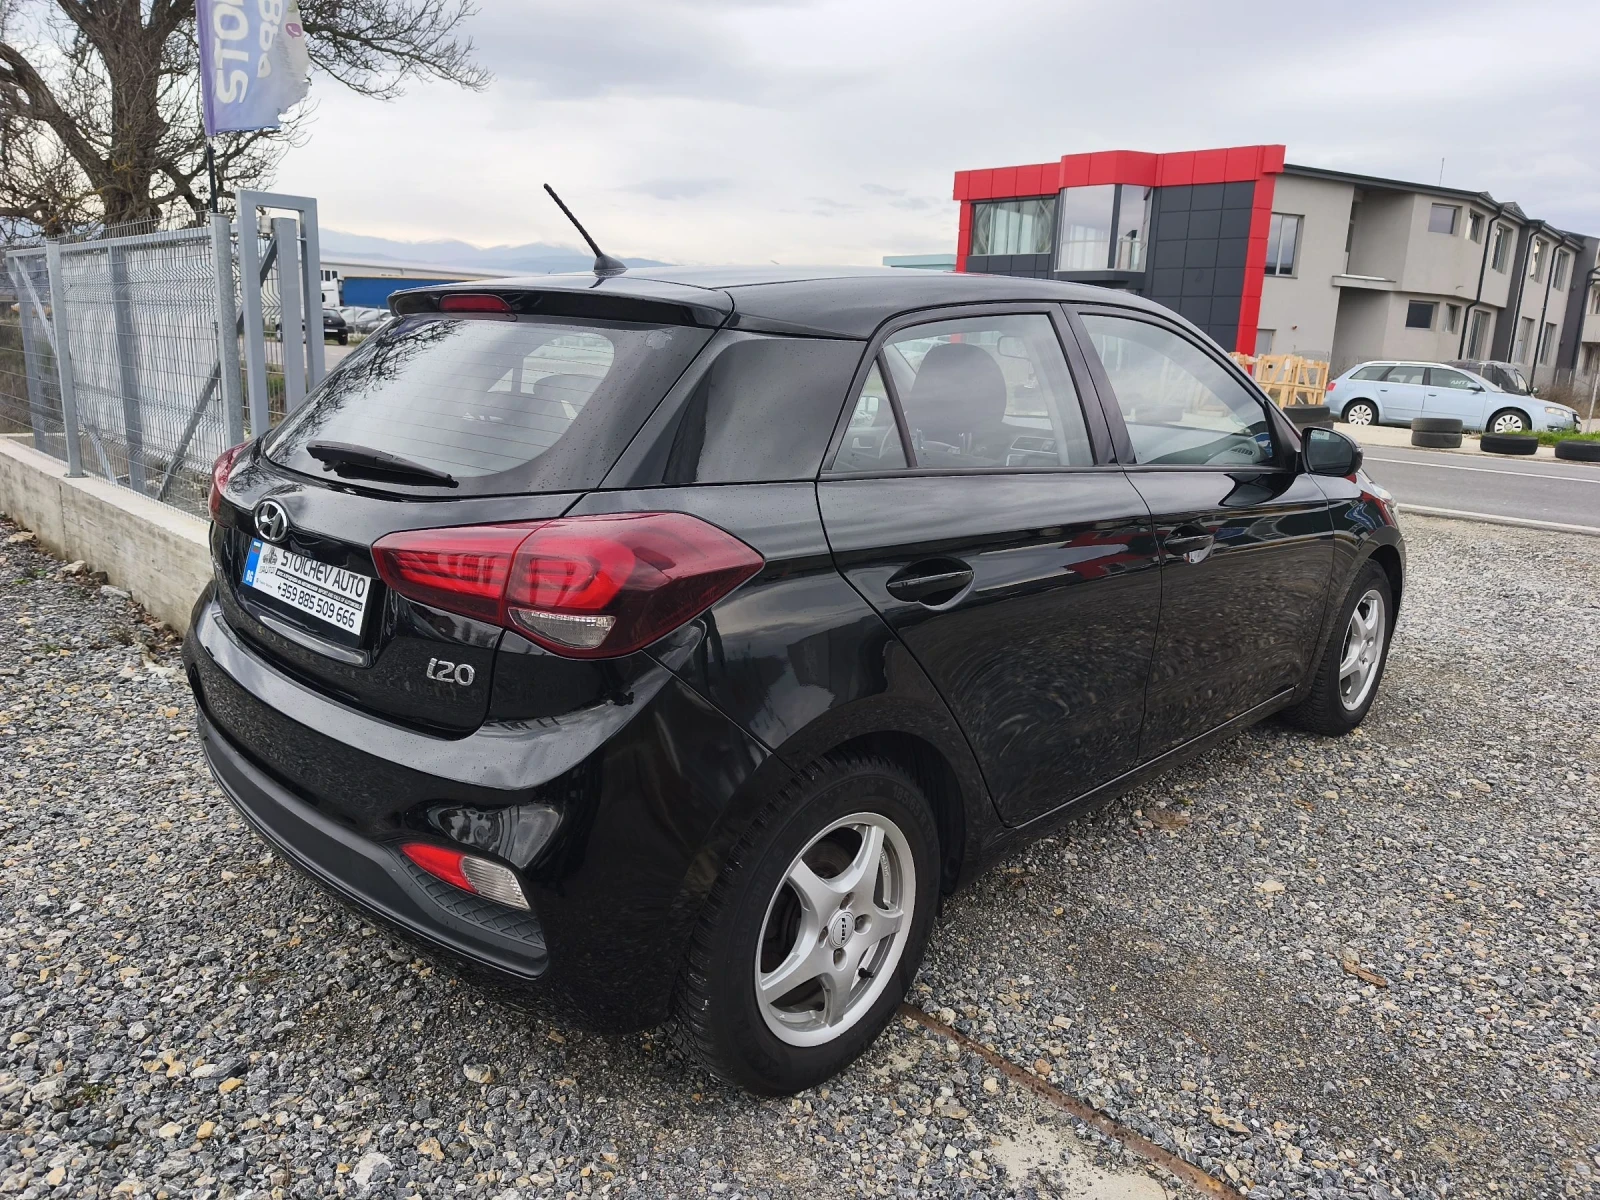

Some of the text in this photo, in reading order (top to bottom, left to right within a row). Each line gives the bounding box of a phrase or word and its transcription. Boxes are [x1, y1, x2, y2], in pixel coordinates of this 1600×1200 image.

[280, 550, 335, 584] STOICHEV
[332, 570, 367, 598] AUTO
[276, 582, 297, 602] +359
[298, 590, 316, 611] 885
[315, 598, 335, 619] 509
[336, 607, 356, 629] 666
[426, 657, 476, 687] i20
